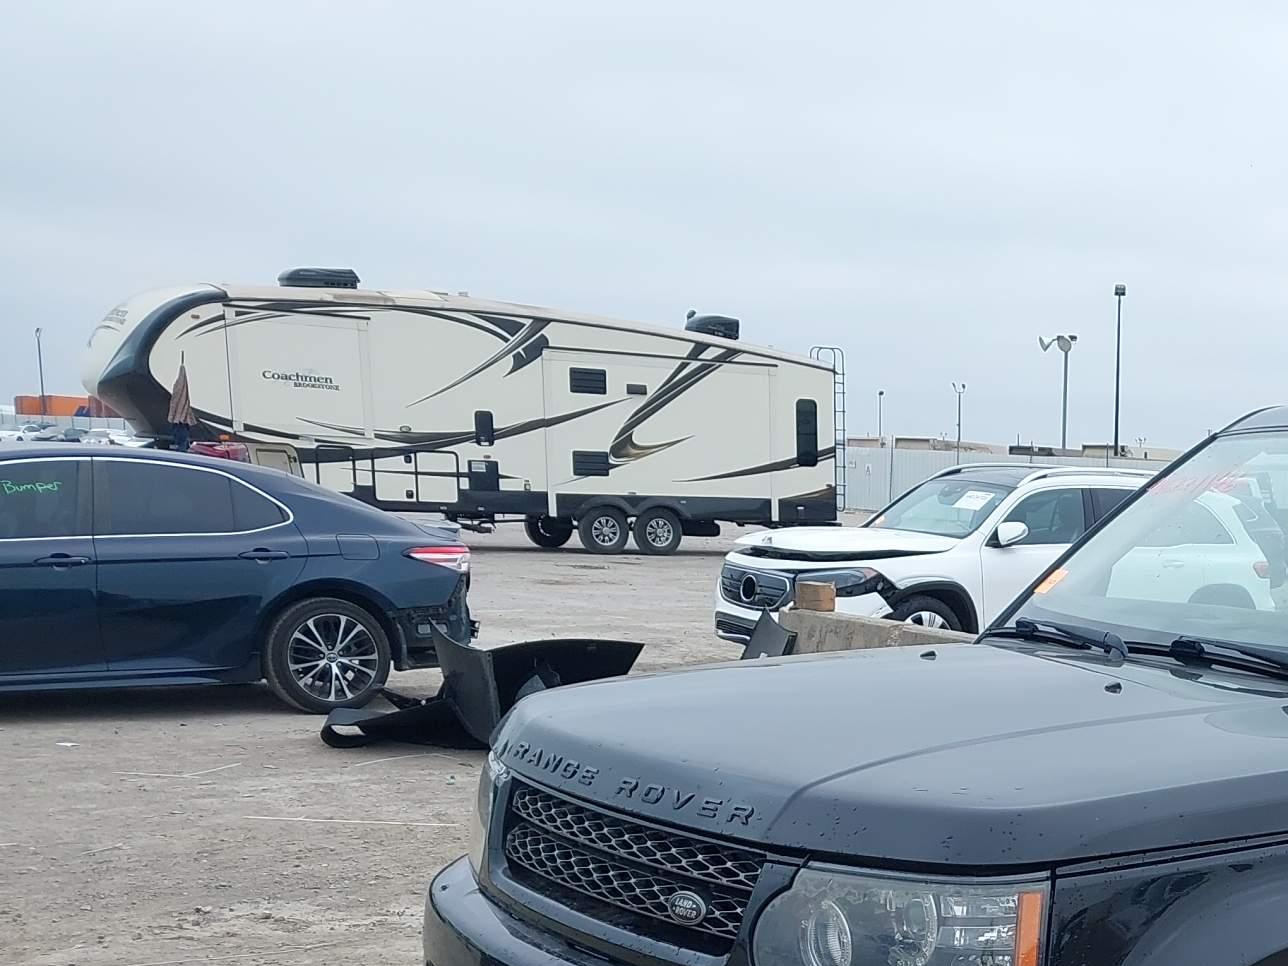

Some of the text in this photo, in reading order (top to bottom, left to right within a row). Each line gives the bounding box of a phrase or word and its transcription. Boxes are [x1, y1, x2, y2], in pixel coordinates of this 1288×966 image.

[262, 370, 333, 385] Coachmen
[0, 480, 63, 495] Bumper
[512, 742, 755, 826] RANGE ROVER
[674, 897, 694, 909] LAND
[674, 905, 698, 919] ROVER
